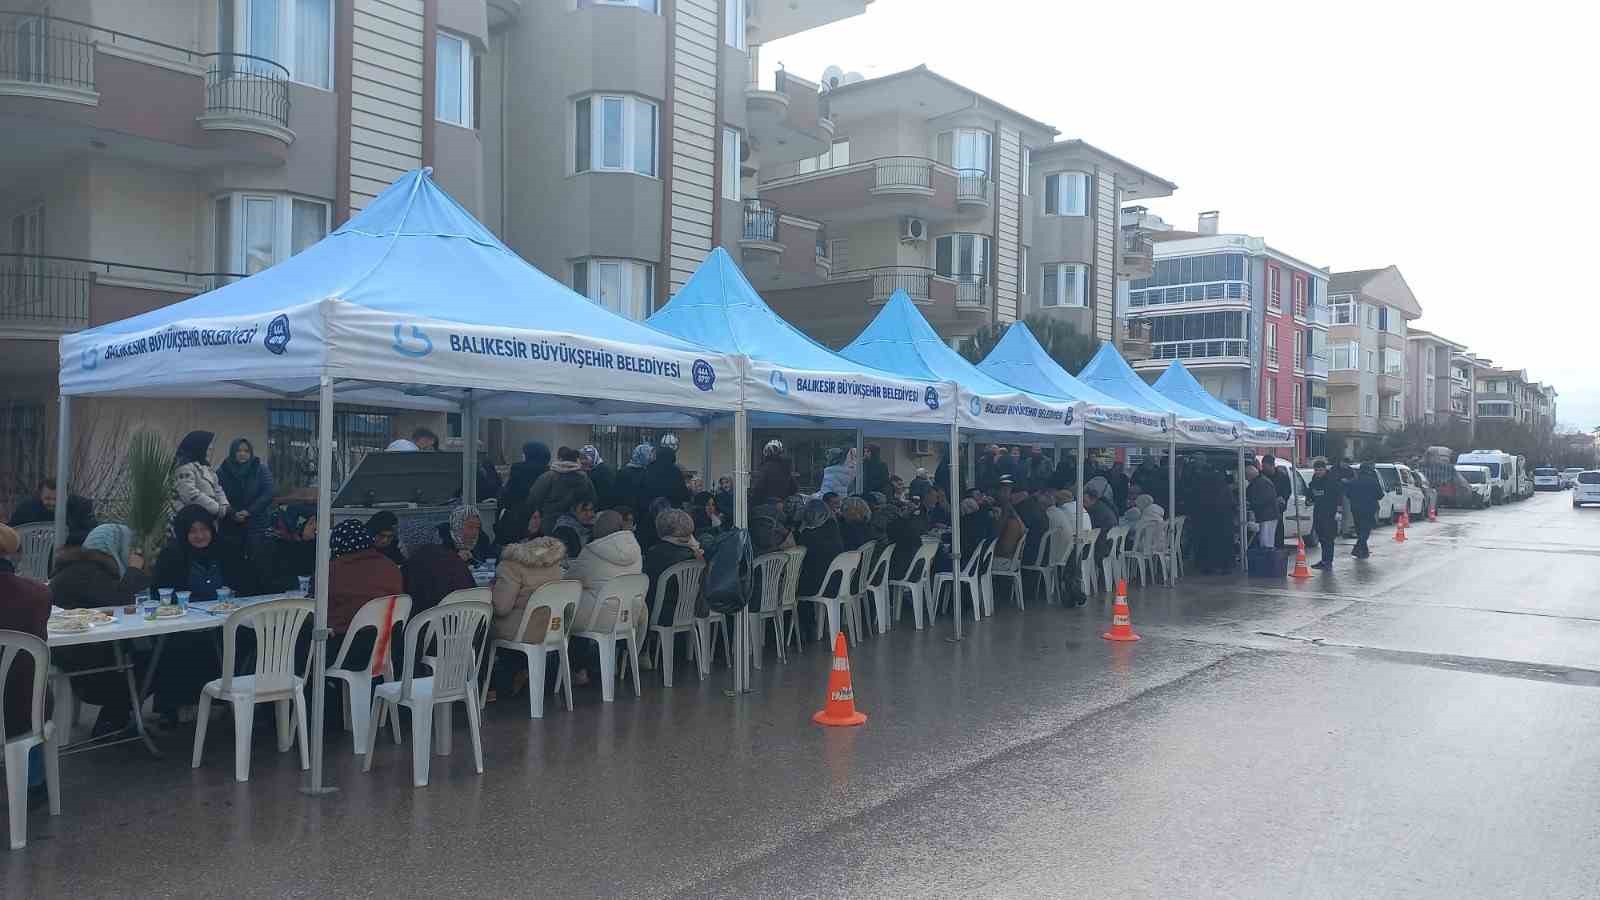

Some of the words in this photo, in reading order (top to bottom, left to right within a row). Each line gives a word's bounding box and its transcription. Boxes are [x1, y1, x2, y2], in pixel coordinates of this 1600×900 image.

[150, 327, 201, 353] BÜYÜKŞEHİR
[450, 333, 527, 358] BALIKESİR
[531, 338, 613, 369] BÜYÜKŞEHİR
[617, 355, 681, 379] BELEDİYESİ
[797, 378, 836, 392] BALIKESİR
[838, 379, 882, 399] BÜYÜKŞEHİR
[882, 386, 919, 403] BELEDİYESİ
